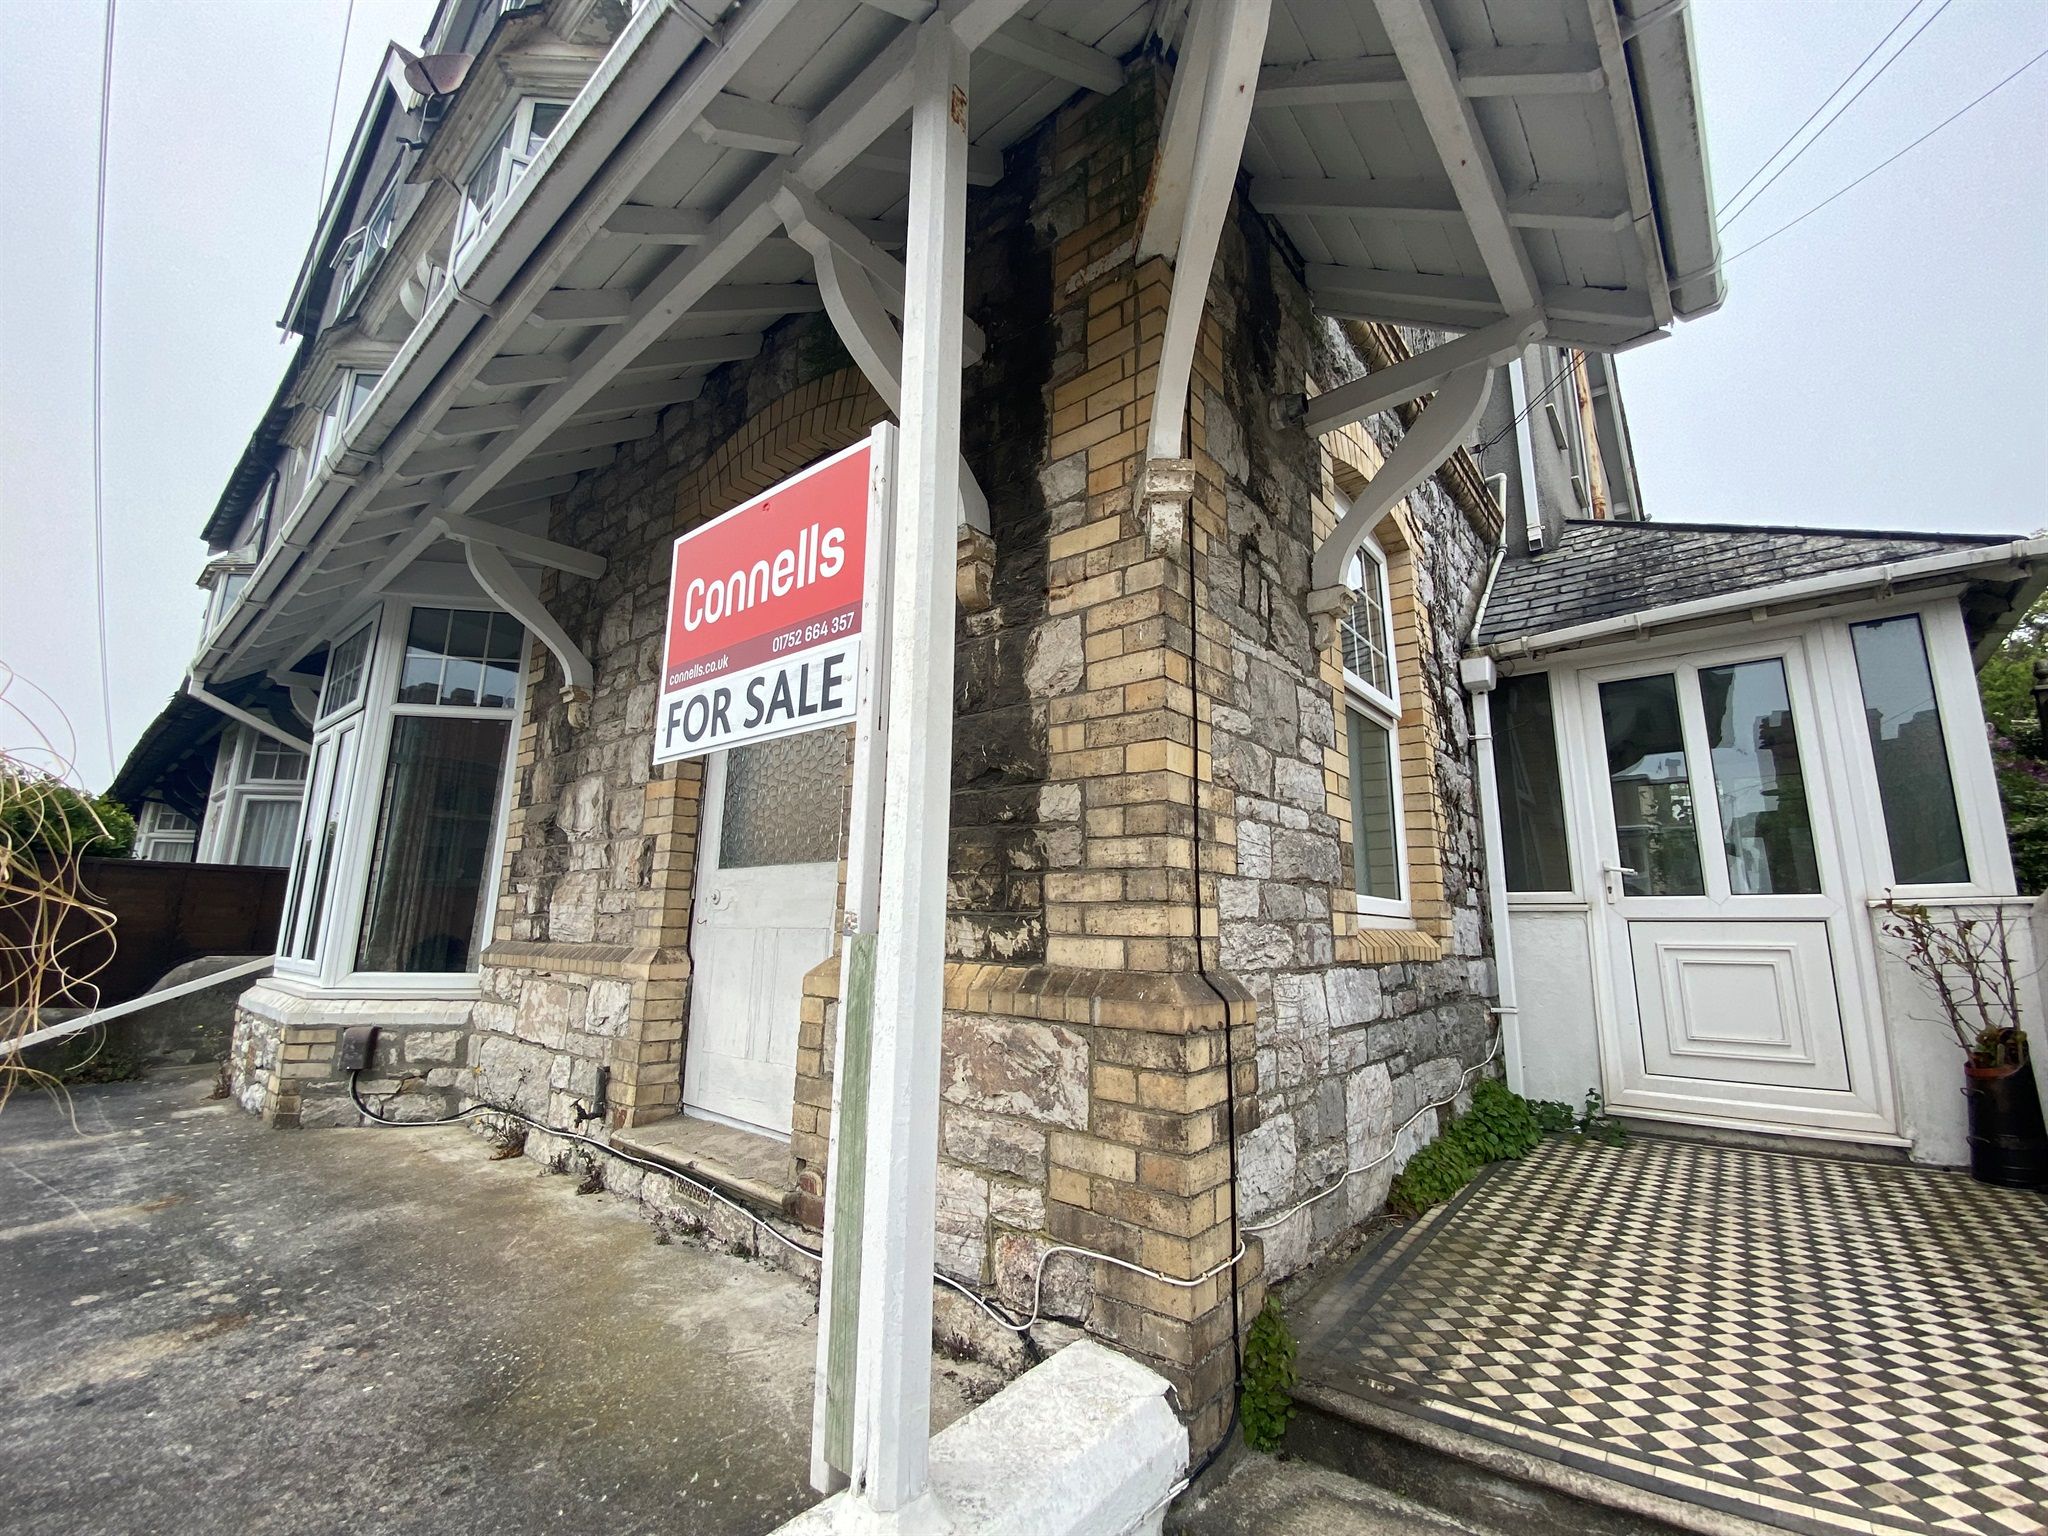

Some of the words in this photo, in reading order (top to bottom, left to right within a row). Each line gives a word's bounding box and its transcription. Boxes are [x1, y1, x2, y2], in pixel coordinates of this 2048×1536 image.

[683, 523, 845, 632] Connells
[772, 629, 802, 652] 01752
[804, 621, 828, 642] 664
[831, 612, 855, 636] 357
[665, 687, 731, 748] FOR
[743, 653, 845, 729] SALE
[669, 654, 729, 686] connells.co.uk
